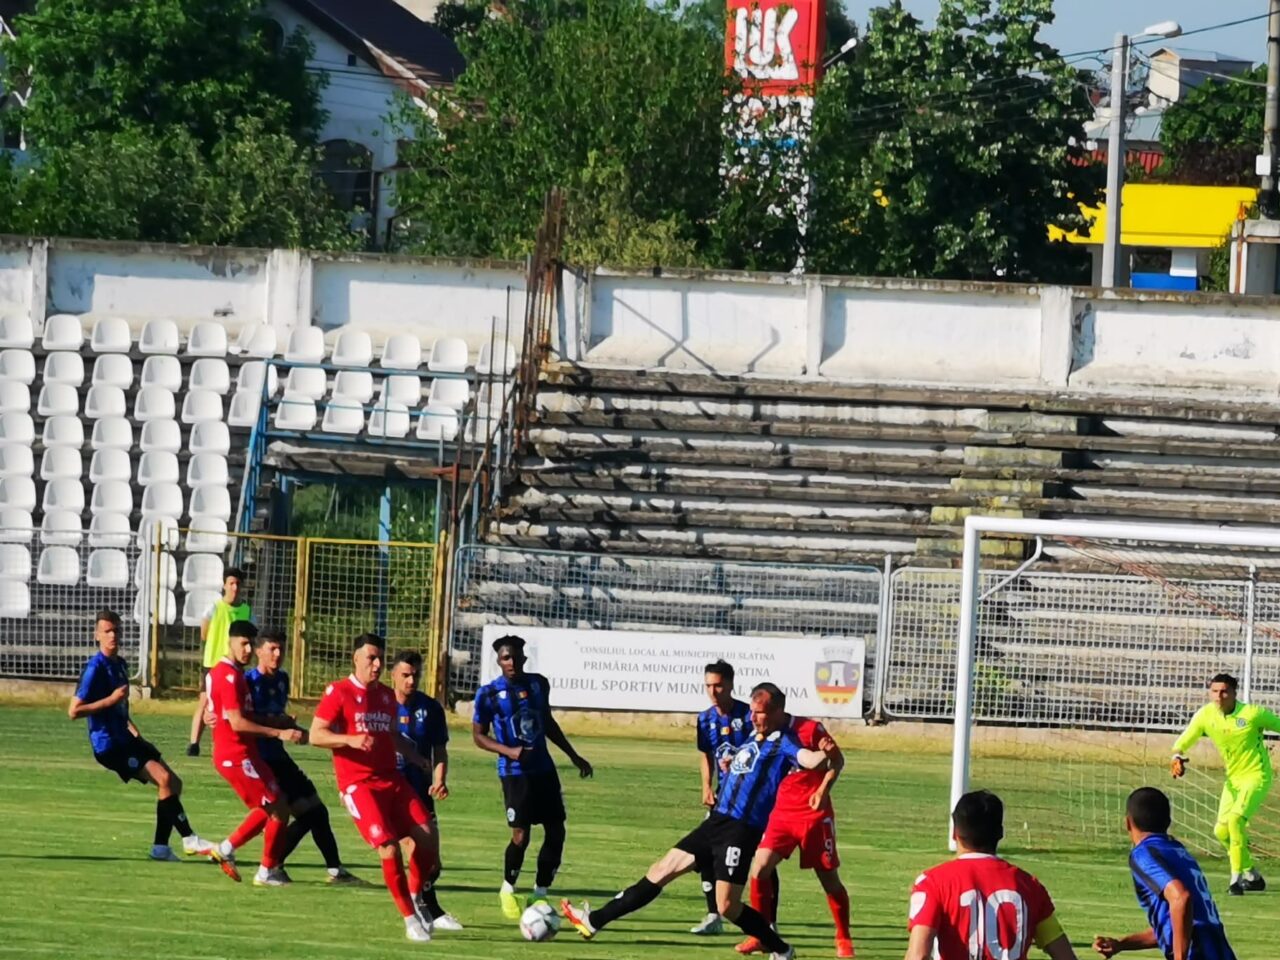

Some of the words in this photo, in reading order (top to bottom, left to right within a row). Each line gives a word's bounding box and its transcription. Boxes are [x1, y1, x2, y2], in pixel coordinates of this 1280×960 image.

[579, 646, 627, 656] CONSILIUL
[629, 647, 657, 657] LOCAL
[659, 648, 671, 657] AL
[672, 649, 736, 660] MUNICIPIULUI
[738, 652, 776, 661] SLATINA
[583, 660, 640, 672] PRIMĂRIA
[642, 663, 705, 674] MUNICIPIU
[550, 677, 598, 691] LUBUL
[601, 680, 663, 694] SPORTIV
[725, 846, 741, 867] 18
